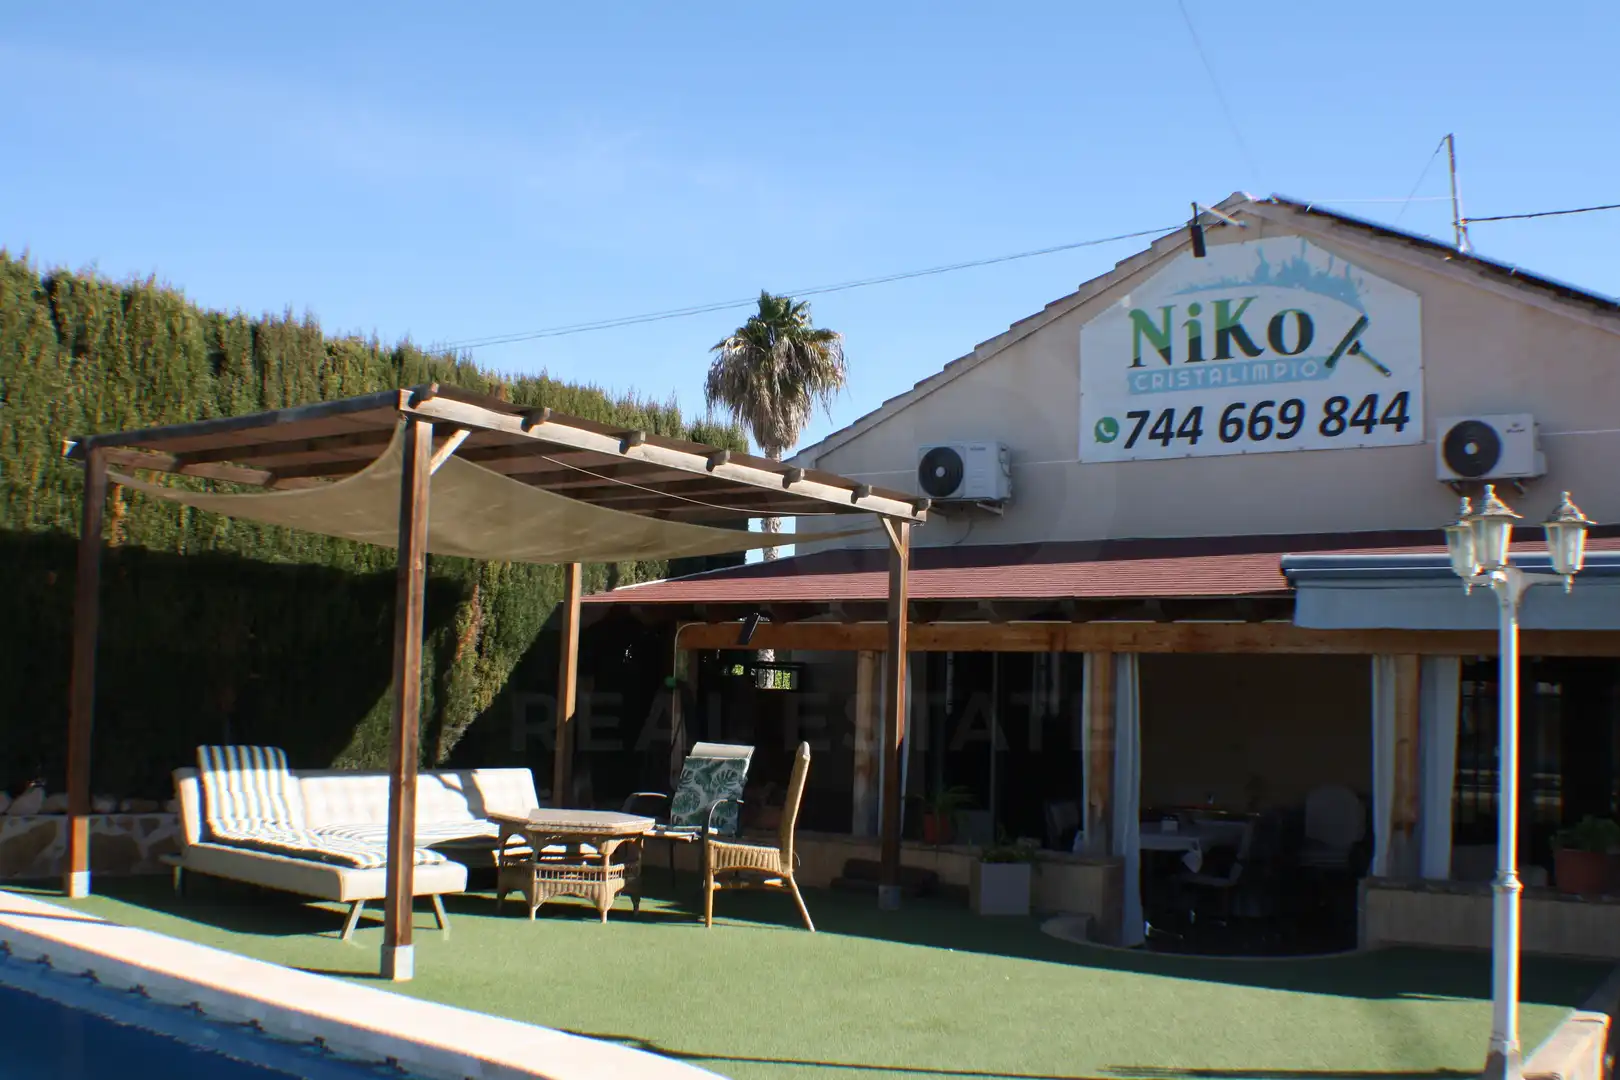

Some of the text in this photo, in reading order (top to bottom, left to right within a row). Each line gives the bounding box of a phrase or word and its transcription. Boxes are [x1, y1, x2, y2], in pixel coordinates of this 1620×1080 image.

[1133, 359, 1320, 392] CRISTALIMPIO
[1124, 390, 1411, 449] 744 669 844
